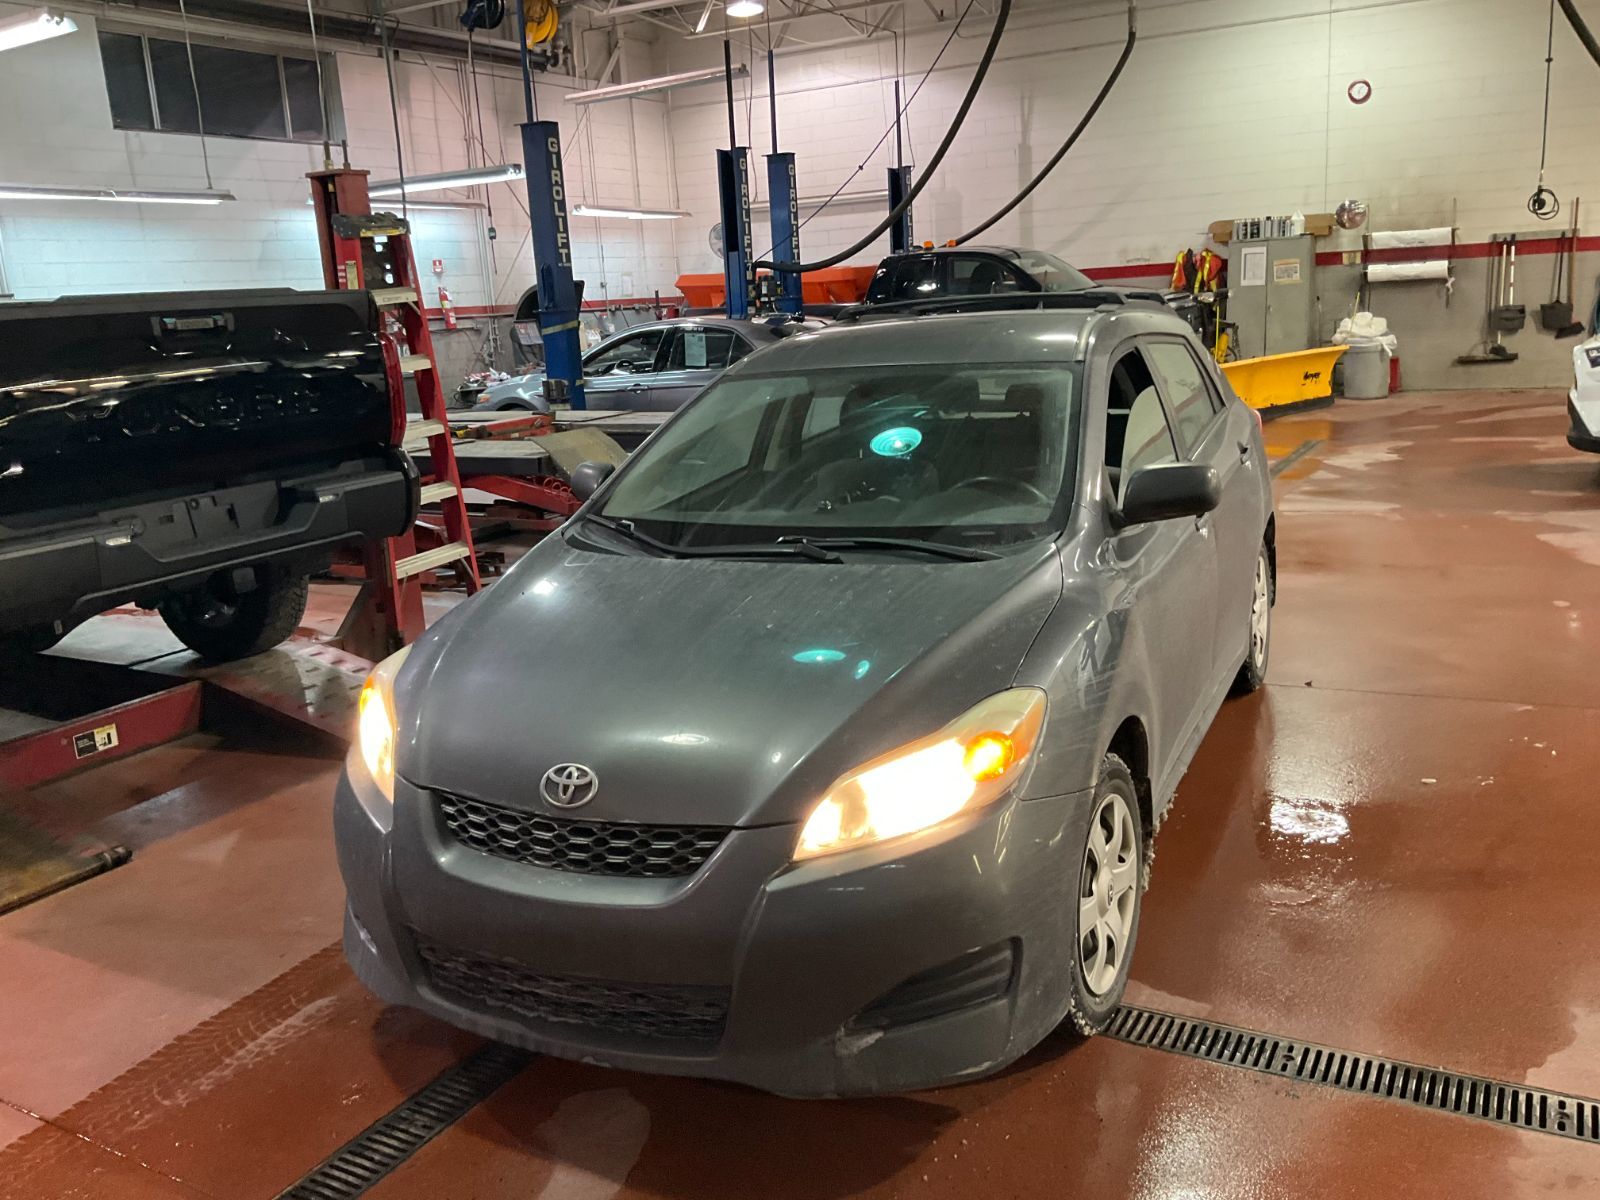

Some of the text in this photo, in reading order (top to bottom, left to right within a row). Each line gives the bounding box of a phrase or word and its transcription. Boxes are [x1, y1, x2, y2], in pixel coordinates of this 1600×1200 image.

[547, 137, 569, 263] GIROLIFT
[740, 158, 752, 261] GIROLIFT
[788, 164, 800, 261] GIROLIFT
